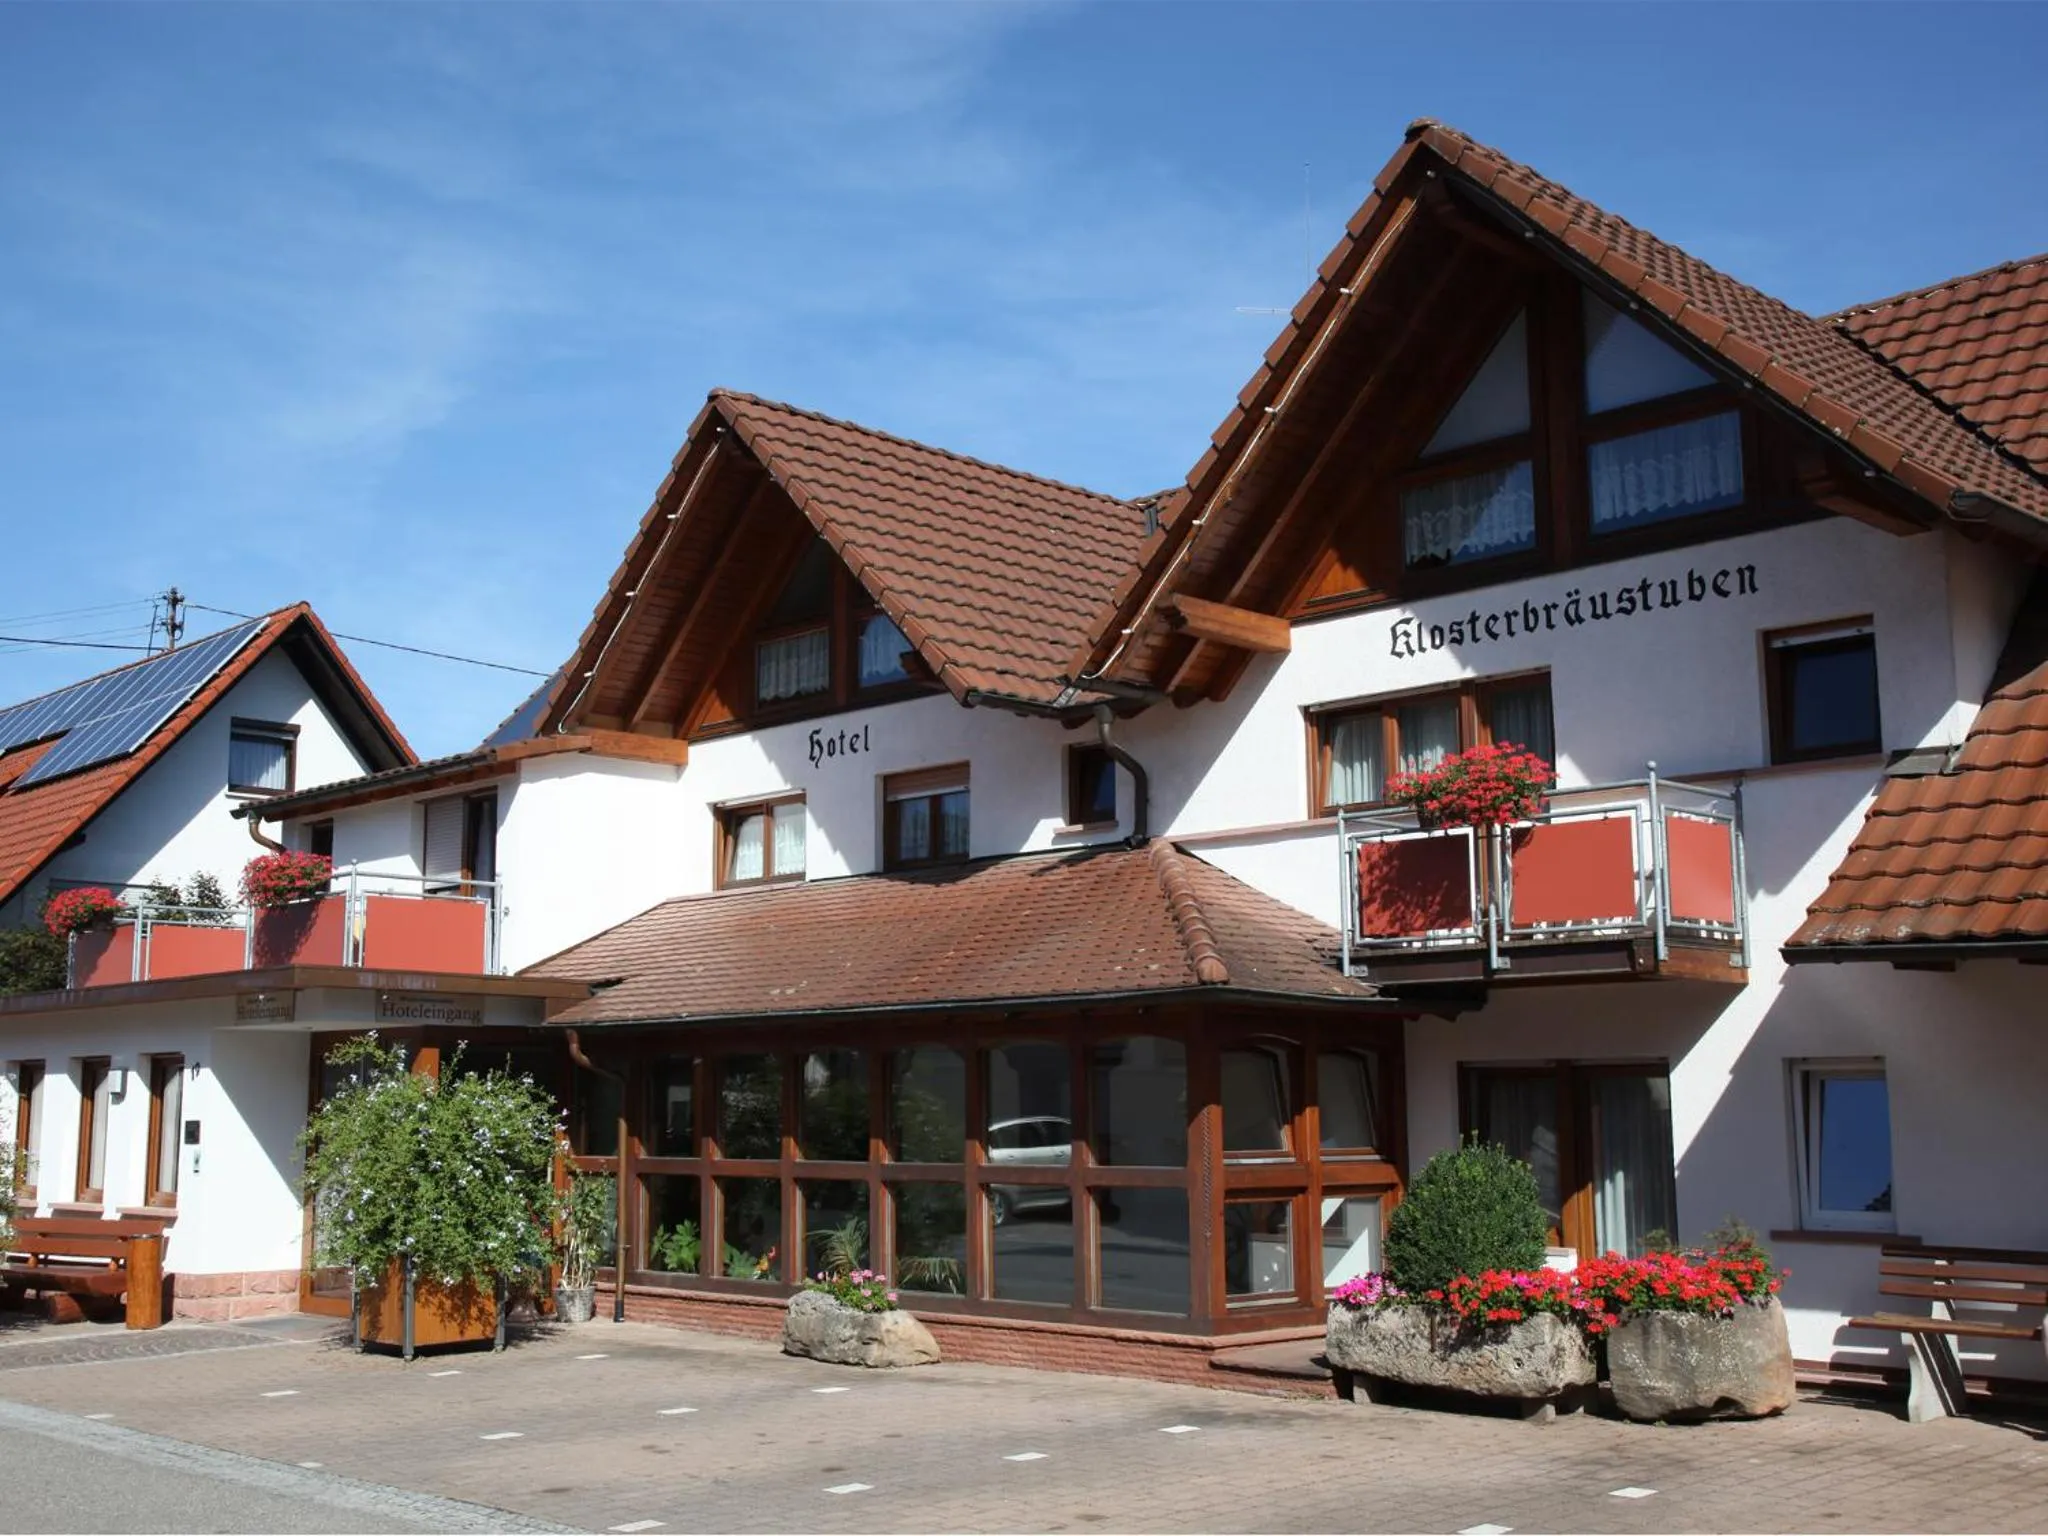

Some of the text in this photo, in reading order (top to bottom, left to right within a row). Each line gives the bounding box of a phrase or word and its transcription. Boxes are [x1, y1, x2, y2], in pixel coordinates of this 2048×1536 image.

[1389, 564, 1759, 659] Klosterbräustuben
[808, 724, 870, 769] Hotel
[382, 1001, 481, 1027] Hoteleingang
